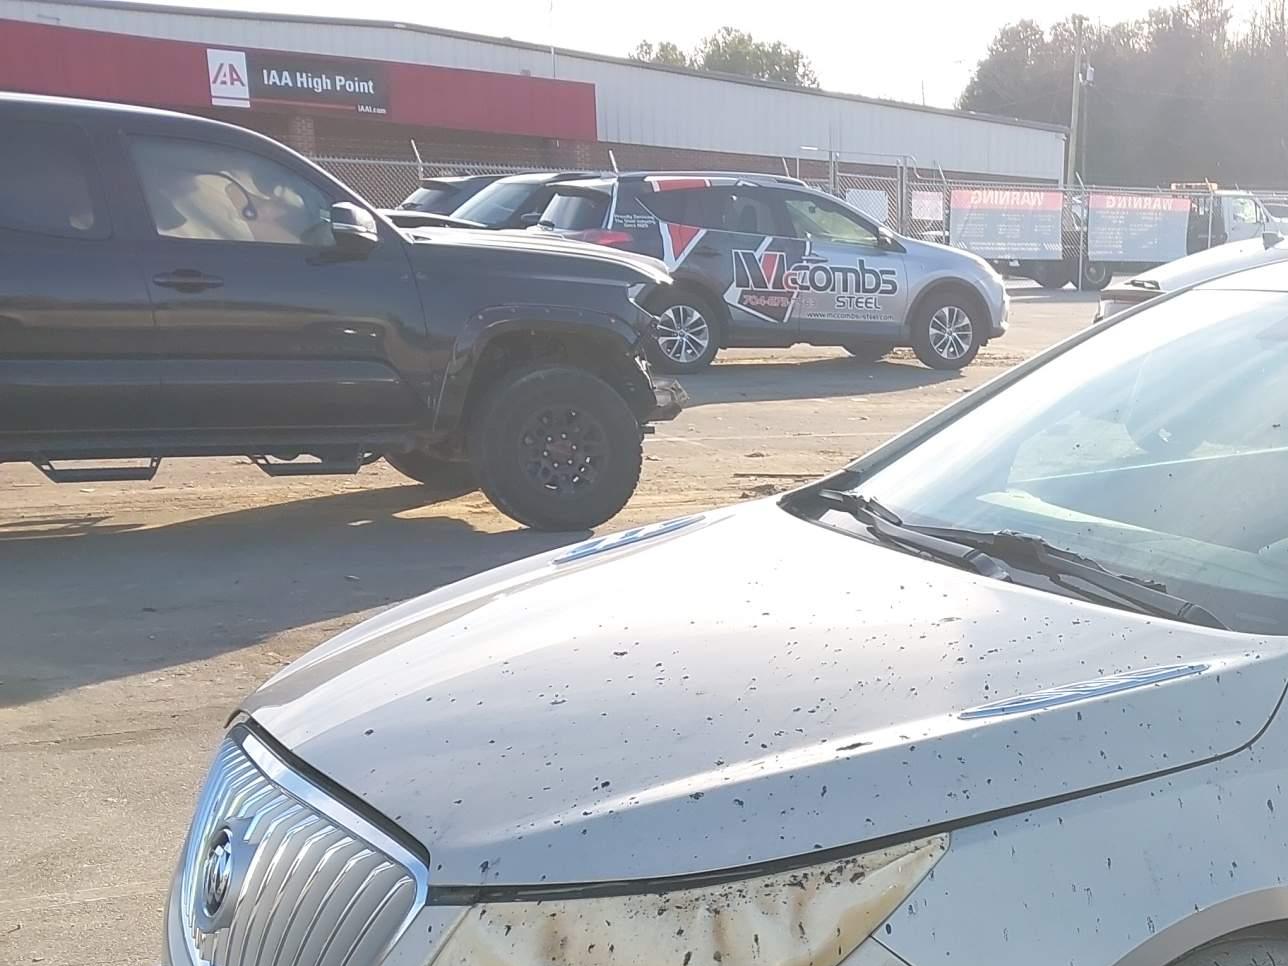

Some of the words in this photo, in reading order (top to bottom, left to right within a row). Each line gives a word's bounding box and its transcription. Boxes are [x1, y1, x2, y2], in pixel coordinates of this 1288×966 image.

[263, 69, 293, 87] IAA
[296, 72, 332, 94] High
[335, 76, 375, 94] Point
[835, 295, 882, 311] STEEL
